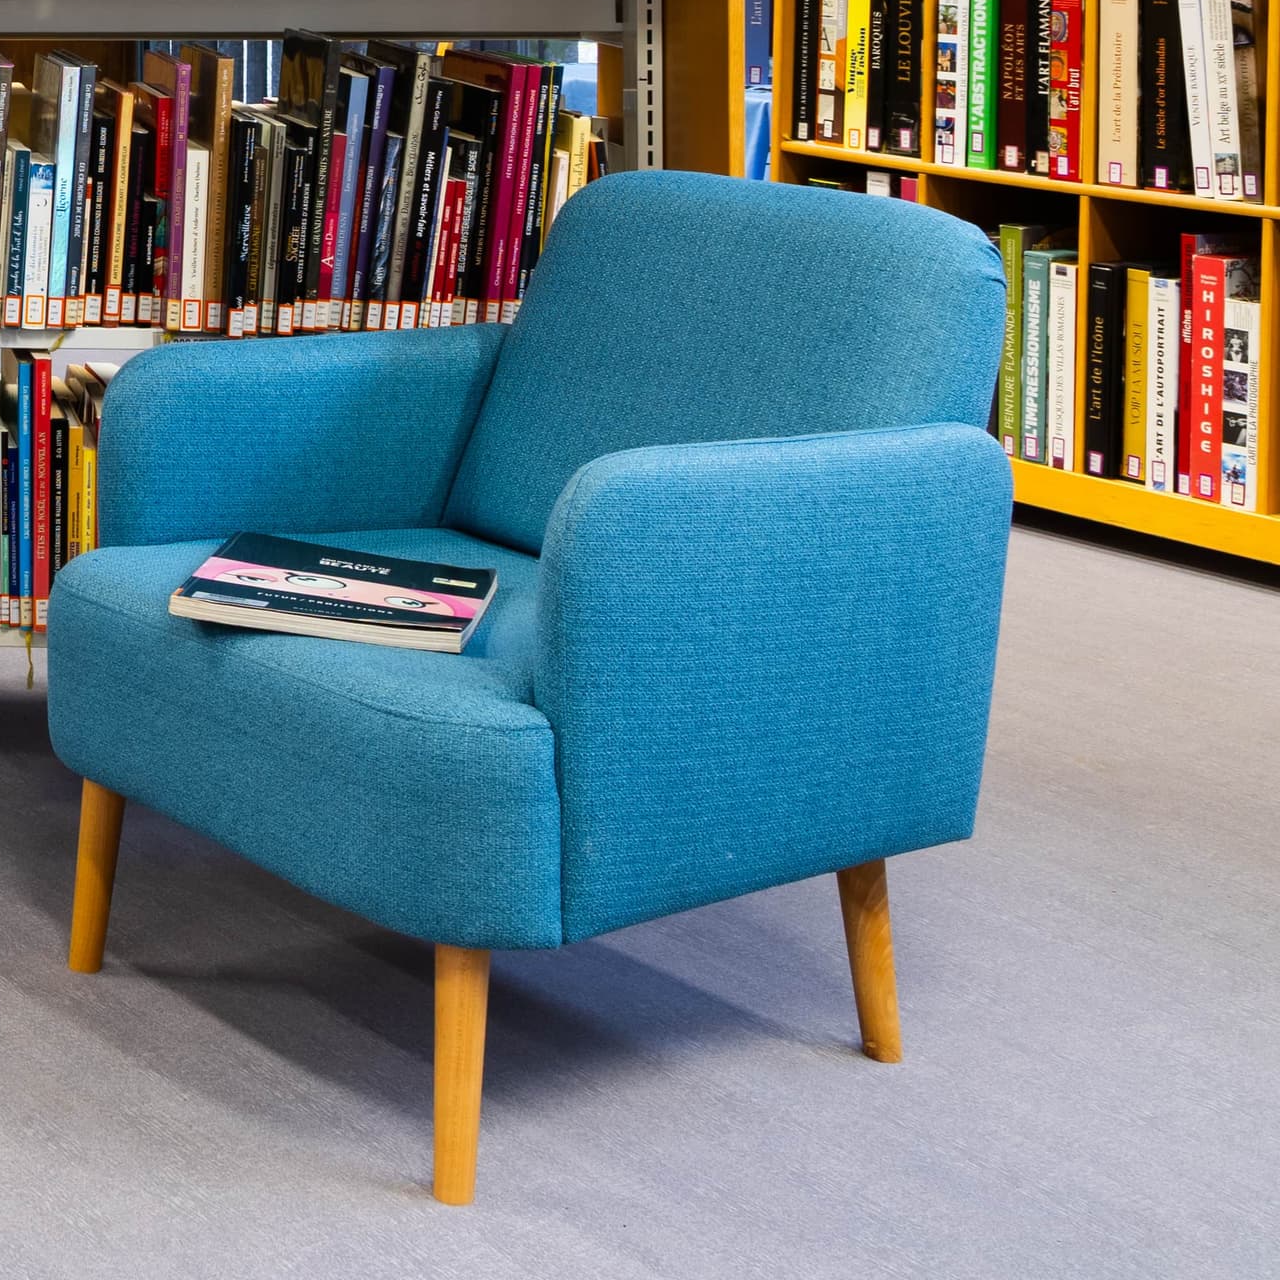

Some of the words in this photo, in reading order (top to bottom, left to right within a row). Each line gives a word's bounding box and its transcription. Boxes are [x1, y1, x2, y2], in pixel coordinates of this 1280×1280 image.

[856, 27, 867, 76] Fashion
[871, 11, 883, 70] BAROQUES
[1015, 23, 1025, 55] ARTS
[846, 48, 858, 94] Vintage
[897, 59, 912, 81] LE
[1001, 23, 1014, 100] NAPOLÉON
[1015, 59, 1025, 81] LES
[1038, 61, 1051, 96] L'ART
[1067, 68, 1080, 88] brut
[1015, 85, 1024, 101] ET
[1067, 90, 1080, 111] l'art
[1005, 307, 1016, 372] FLAMANDE
[1090, 316, 1105, 364] l'Icône
[1181, 309, 1193, 344] affiches
[1024, 279, 1041, 439] L'IMPRESSIONNISME
[1090, 367, 1103, 385] de
[1155, 306, 1166, 408] L'AUTOPORTRAIT
[1200, 290, 1214, 454] HIROSHIGE
[1003, 376, 1016, 430] PEINTURE
[1089, 388, 1103, 421] L'art
